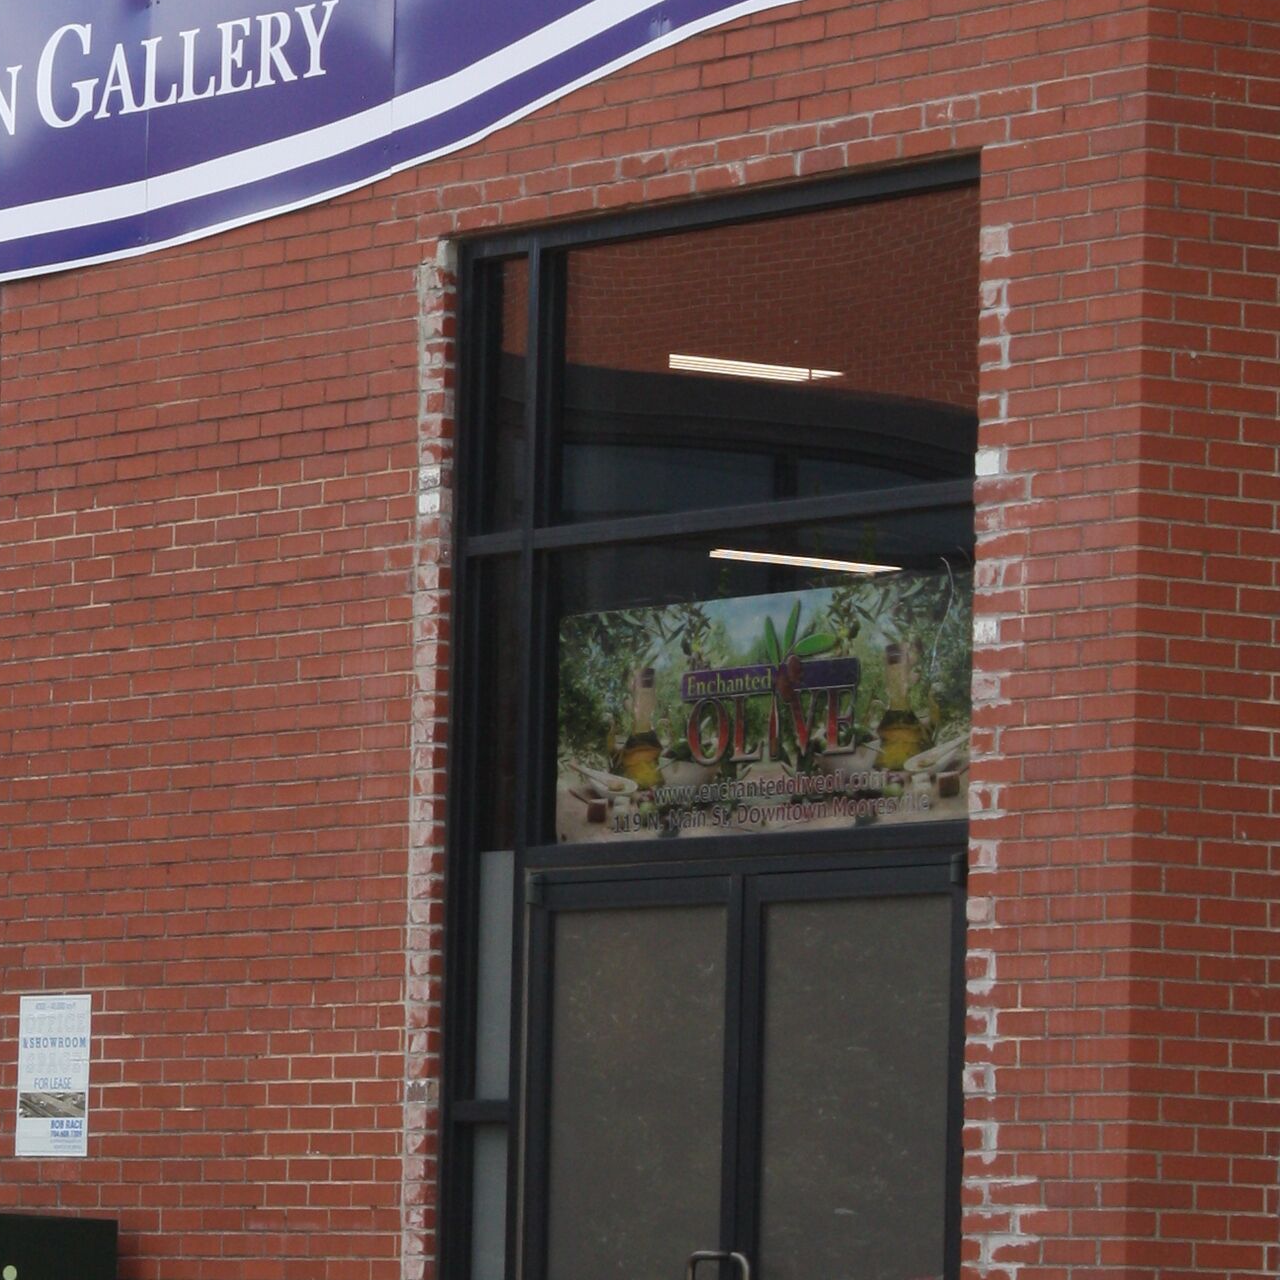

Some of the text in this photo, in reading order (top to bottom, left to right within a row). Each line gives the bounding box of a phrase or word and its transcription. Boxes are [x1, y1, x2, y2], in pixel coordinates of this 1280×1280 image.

[687, 668, 772, 697] Enchanted
[687, 687, 856, 766] OLIVE
[654, 769, 887, 807] www.enchantedoliveoil.com
[614, 811, 642, 834] 119
[647, 808, 664, 832] N.
[669, 804, 707, 831] Main
[737, 801, 828, 825] Downtown
[832, 792, 930, 818] Mooresville
[29, 1036, 87, 1048] SHOWROOM
[34, 1077, 72, 1089] FOR LEASE
